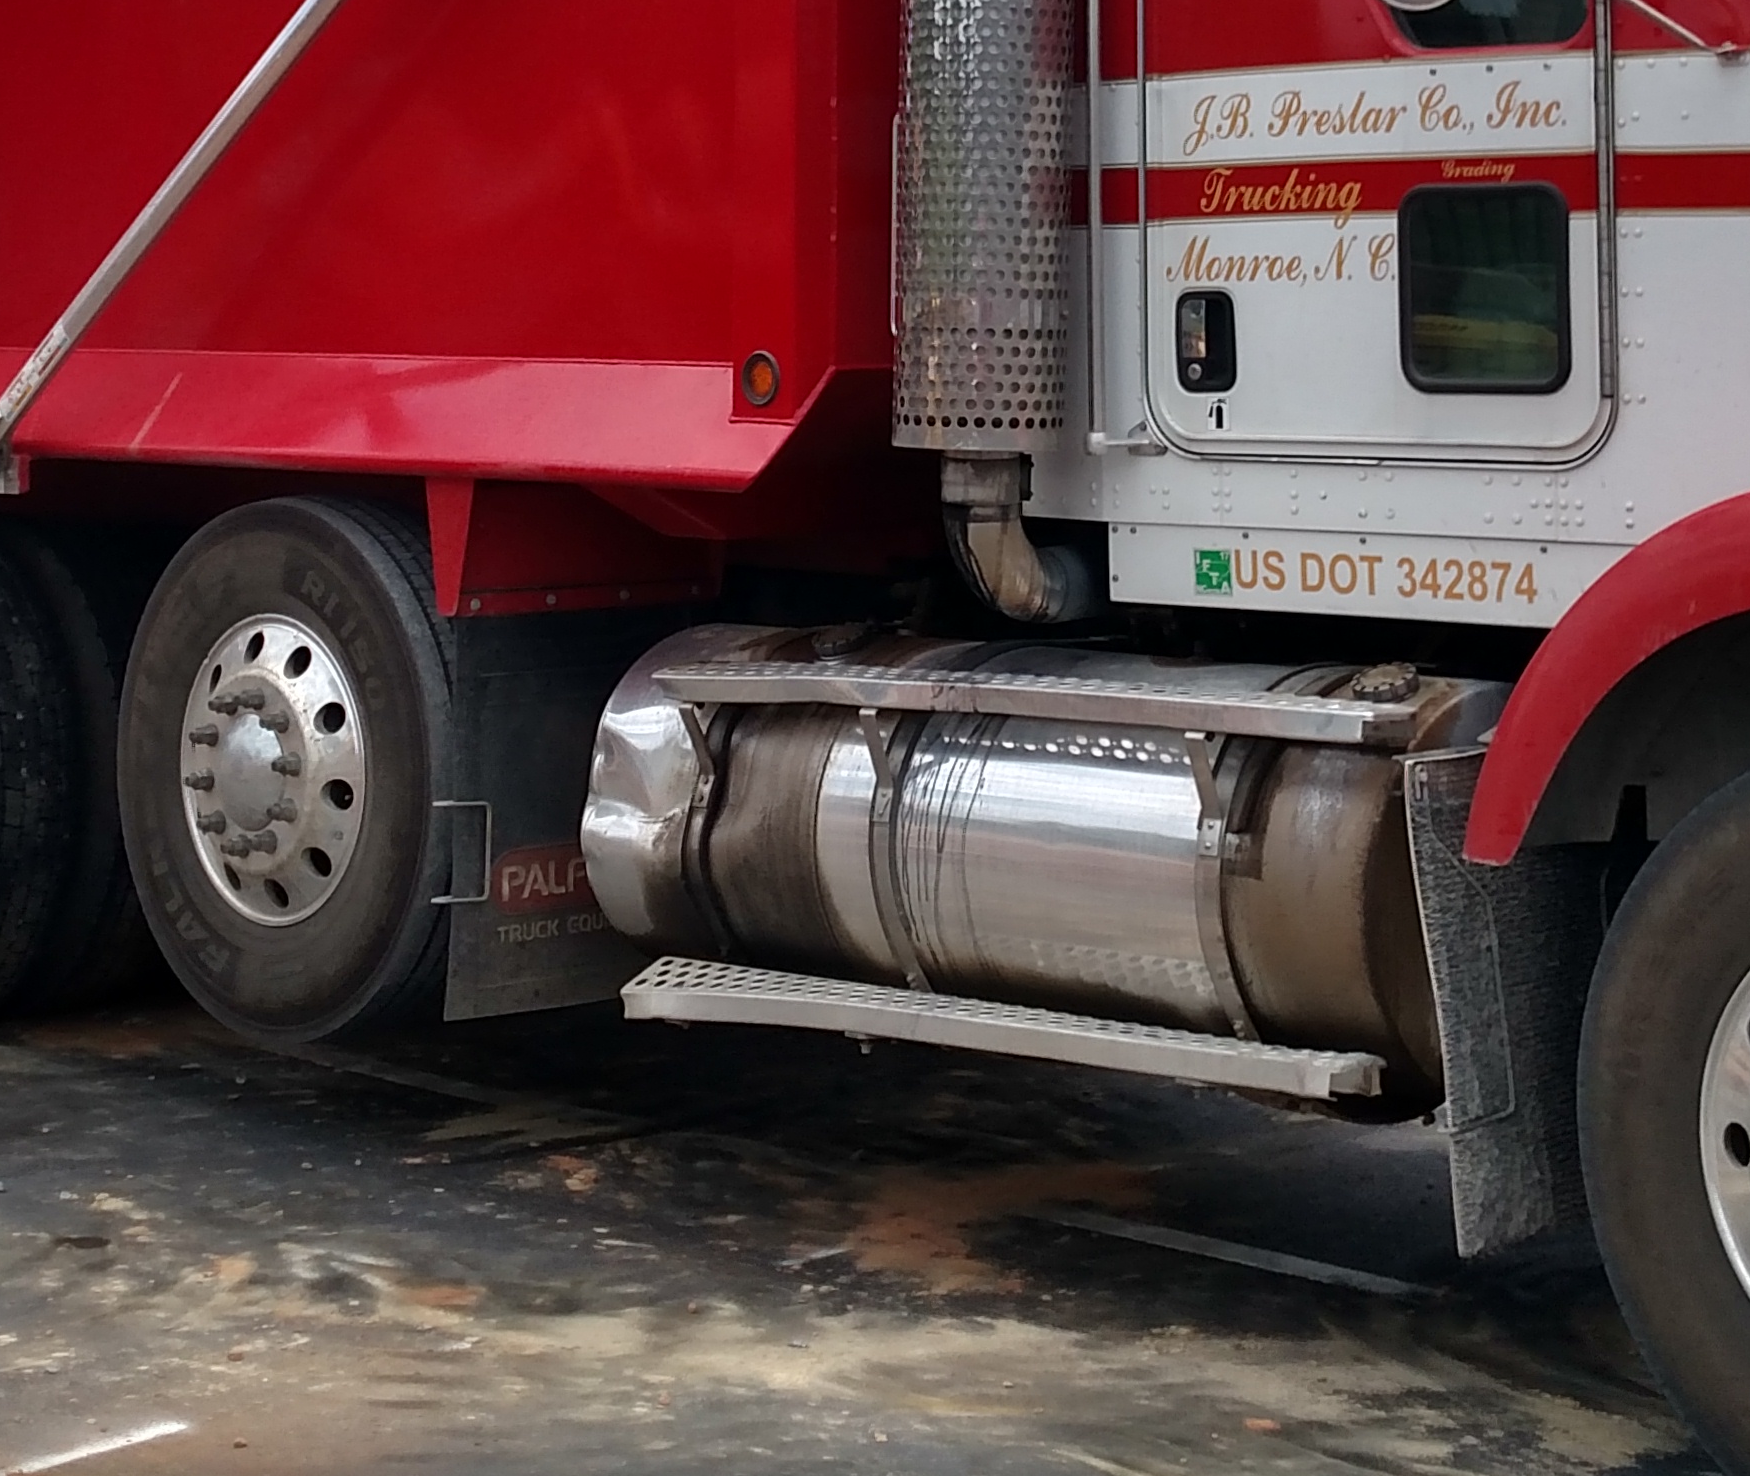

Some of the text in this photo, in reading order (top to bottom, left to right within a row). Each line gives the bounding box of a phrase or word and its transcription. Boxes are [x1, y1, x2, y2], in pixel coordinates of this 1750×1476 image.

[1183, 93, 1254, 156] J.B.
[1486, 80, 1568, 129] Inc.
[1441, 158, 1516, 183] Grading
[1200, 167, 1363, 230] Trucking
[1166, 234, 1308, 287] Monroe,
[1234, 549, 1538, 604] US DOT 342874
[497, 918, 560, 943] TRUCK
